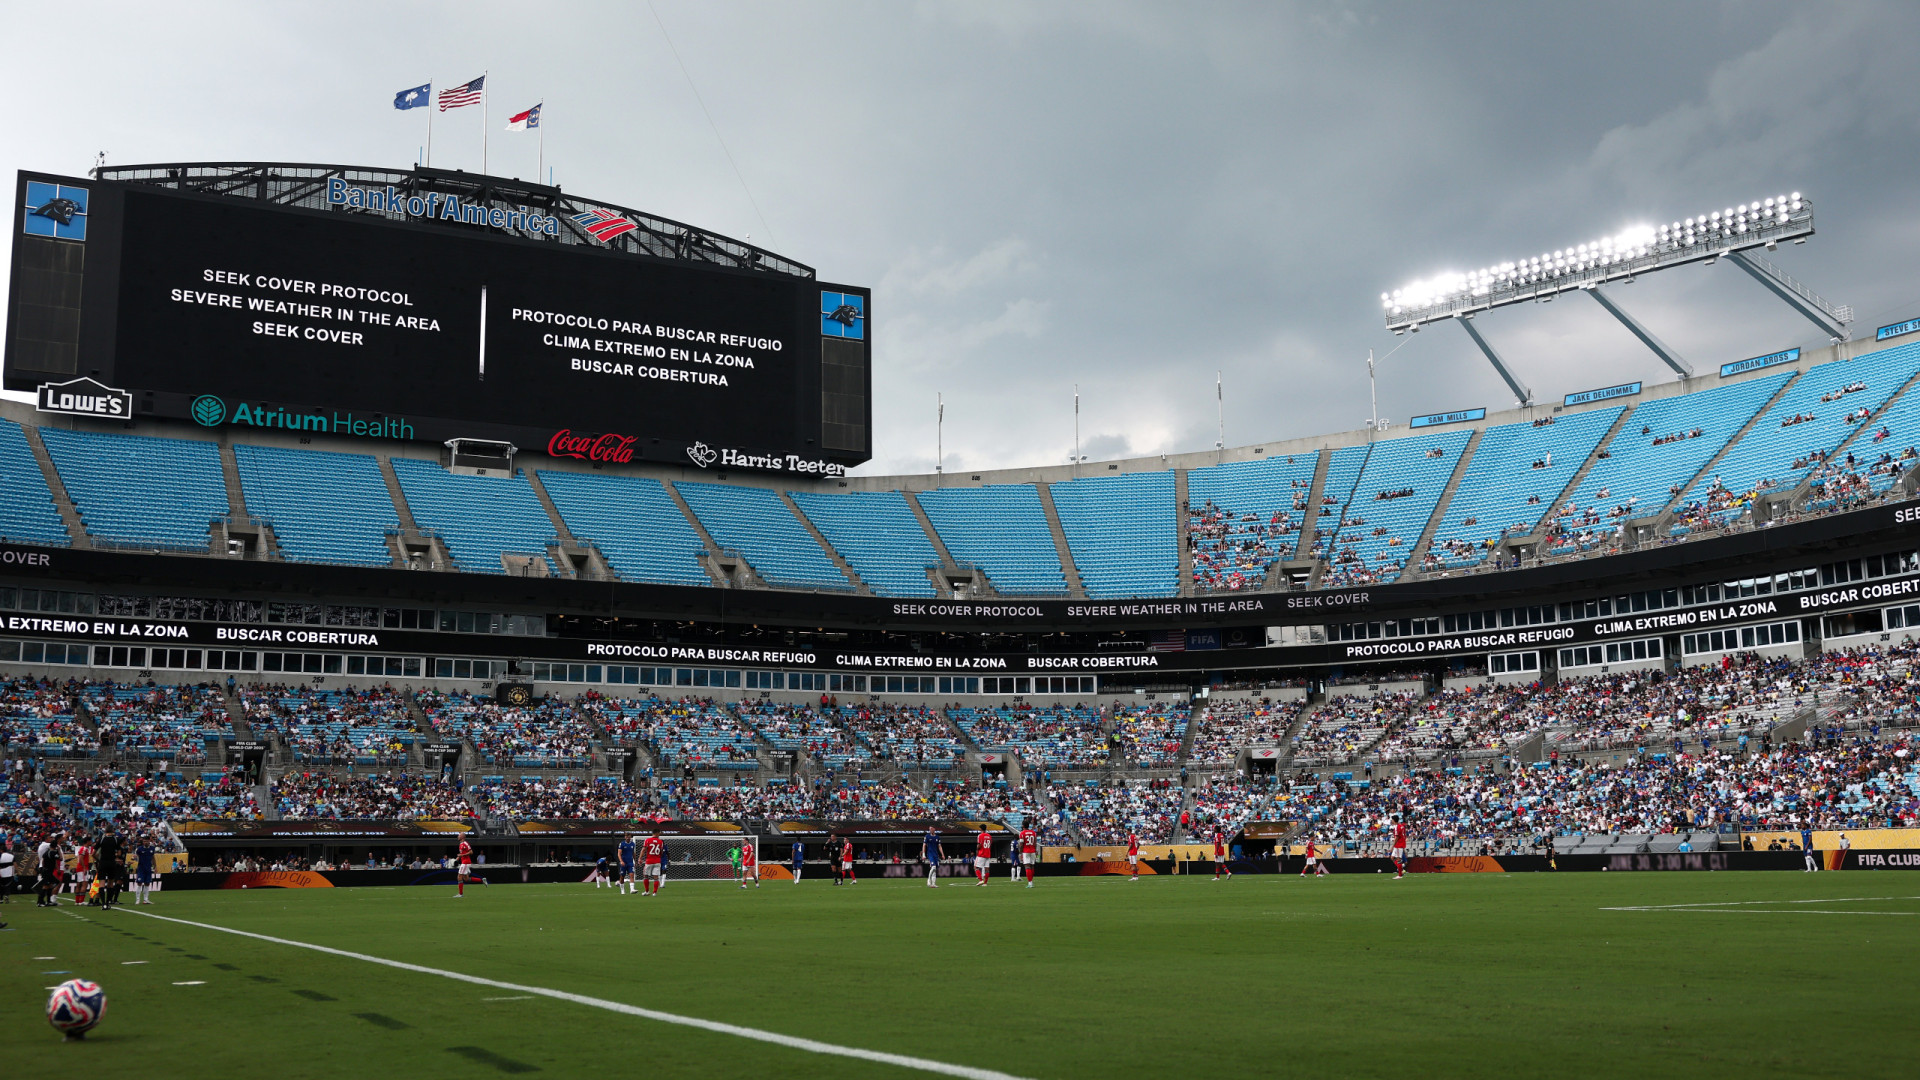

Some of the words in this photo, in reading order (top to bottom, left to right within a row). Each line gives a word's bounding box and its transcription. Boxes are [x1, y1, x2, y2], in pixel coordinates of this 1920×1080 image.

[327, 177, 404, 213] Bank
[407, 192, 438, 218] of
[440, 195, 559, 236] America
[203, 269, 251, 286] SEEK
[255, 275, 316, 294] COVER
[321, 283, 413, 306] PROTOCOL
[171, 288, 242, 309] SEVERE
[248, 297, 333, 319] WEATHER
[337, 308, 353, 321] IN
[359, 310, 391, 326] THE
[395, 316, 441, 331] AREA
[252, 321, 299, 338] SEEK
[304, 327, 363, 345] COVER
[512, 308, 608, 330] PROTOCOLO
[612, 320, 652, 335] PARA
[656, 325, 716, 343] BUSCAR
[720, 333, 782, 351] REFUGIO
[1884, 323, 1909, 336] STEVE
[543, 334, 590, 350] CLIMA
[594, 339, 666, 358] EXTREMO
[670, 348, 689, 361] EN
[694, 350, 712, 364] LA
[715, 354, 754, 368] ZONA
[571, 358, 634, 376] BUSCAR
[638, 366, 728, 386] COBERTURA
[1730, 359, 1761, 373] JORDAN
[1763, 352, 1789, 365] GROSS
[47, 389, 123, 415] LOWE'S
[1572, 392, 1590, 403] JAKE
[1593, 385, 1634, 400] DELHOMME
[231, 402, 328, 432] Atrium
[333, 411, 414, 440] Health
[1428, 414, 1445, 424] SAM
[1447, 412, 1468, 422] MILLS
[547, 429, 639, 464] Coca-Cola
[721, 448, 782, 470] Harris
[785, 455, 845, 476] Teeter
[0, 551, 50, 566] OVER
[1287, 596, 1322, 608] SEEK
[1326, 592, 1369, 605] COVER
[1800, 589, 1858, 609] BUSCAR
[1862, 579, 1920, 599] COBERT
[893, 604, 926, 615] SEEK
[929, 605, 972, 615] COVER
[975, 606, 1043, 616] PROTOCOL
[1067, 605, 1117, 616] SEVERE
[1120, 604, 1181, 616] WEATHER
[1185, 603, 1197, 613] IN
[1201, 602, 1225, 613] THE
[1228, 600, 1263, 611] AREA
[1594, 618, 1633, 635] CLIMA
[1635, 613, 1697, 631] EXTREMO
[1700, 609, 1717, 622] EN
[1720, 606, 1737, 618] LA
[1740, 601, 1777, 616] ZONA
[9, 617, 89, 633] EXTREMO
[93, 622, 115, 635] EN
[120, 624, 141, 636] LA
[144, 624, 189, 638] ZONA
[216, 627, 282, 642] BUSCAR
[286, 630, 378, 646] COBERTURA
[1191, 635, 1215, 644] FIFA
[1346, 641, 1425, 657] PROTOCOLO
[1428, 637, 1461, 652] PARA
[1464, 633, 1515, 648] BUSCAR
[1519, 627, 1575, 643] REFUGIO
[587, 643, 668, 657] PROTOCOLO
[671, 648, 705, 659] PARA
[708, 649, 760, 661] BUSCAR
[763, 651, 816, 664] REFUGIO
[836, 655, 872, 666] CLIMA
[875, 656, 933, 667] EXTREMO
[936, 657, 952, 667] EN
[955, 658, 971, 667] LA
[972, 658, 1007, 668] ZONA
[1028, 657, 1078, 668] BUSCAR
[1082, 655, 1158, 667] COBERTURA
[649, 844, 660, 855] 26
[1025, 836, 1034, 845] 30
[1858, 854, 1886, 865] FIFA
[1887, 854, 1920, 865] CLUB
[289, 872, 311, 886] CUP
[760, 866, 778, 878] CUP
